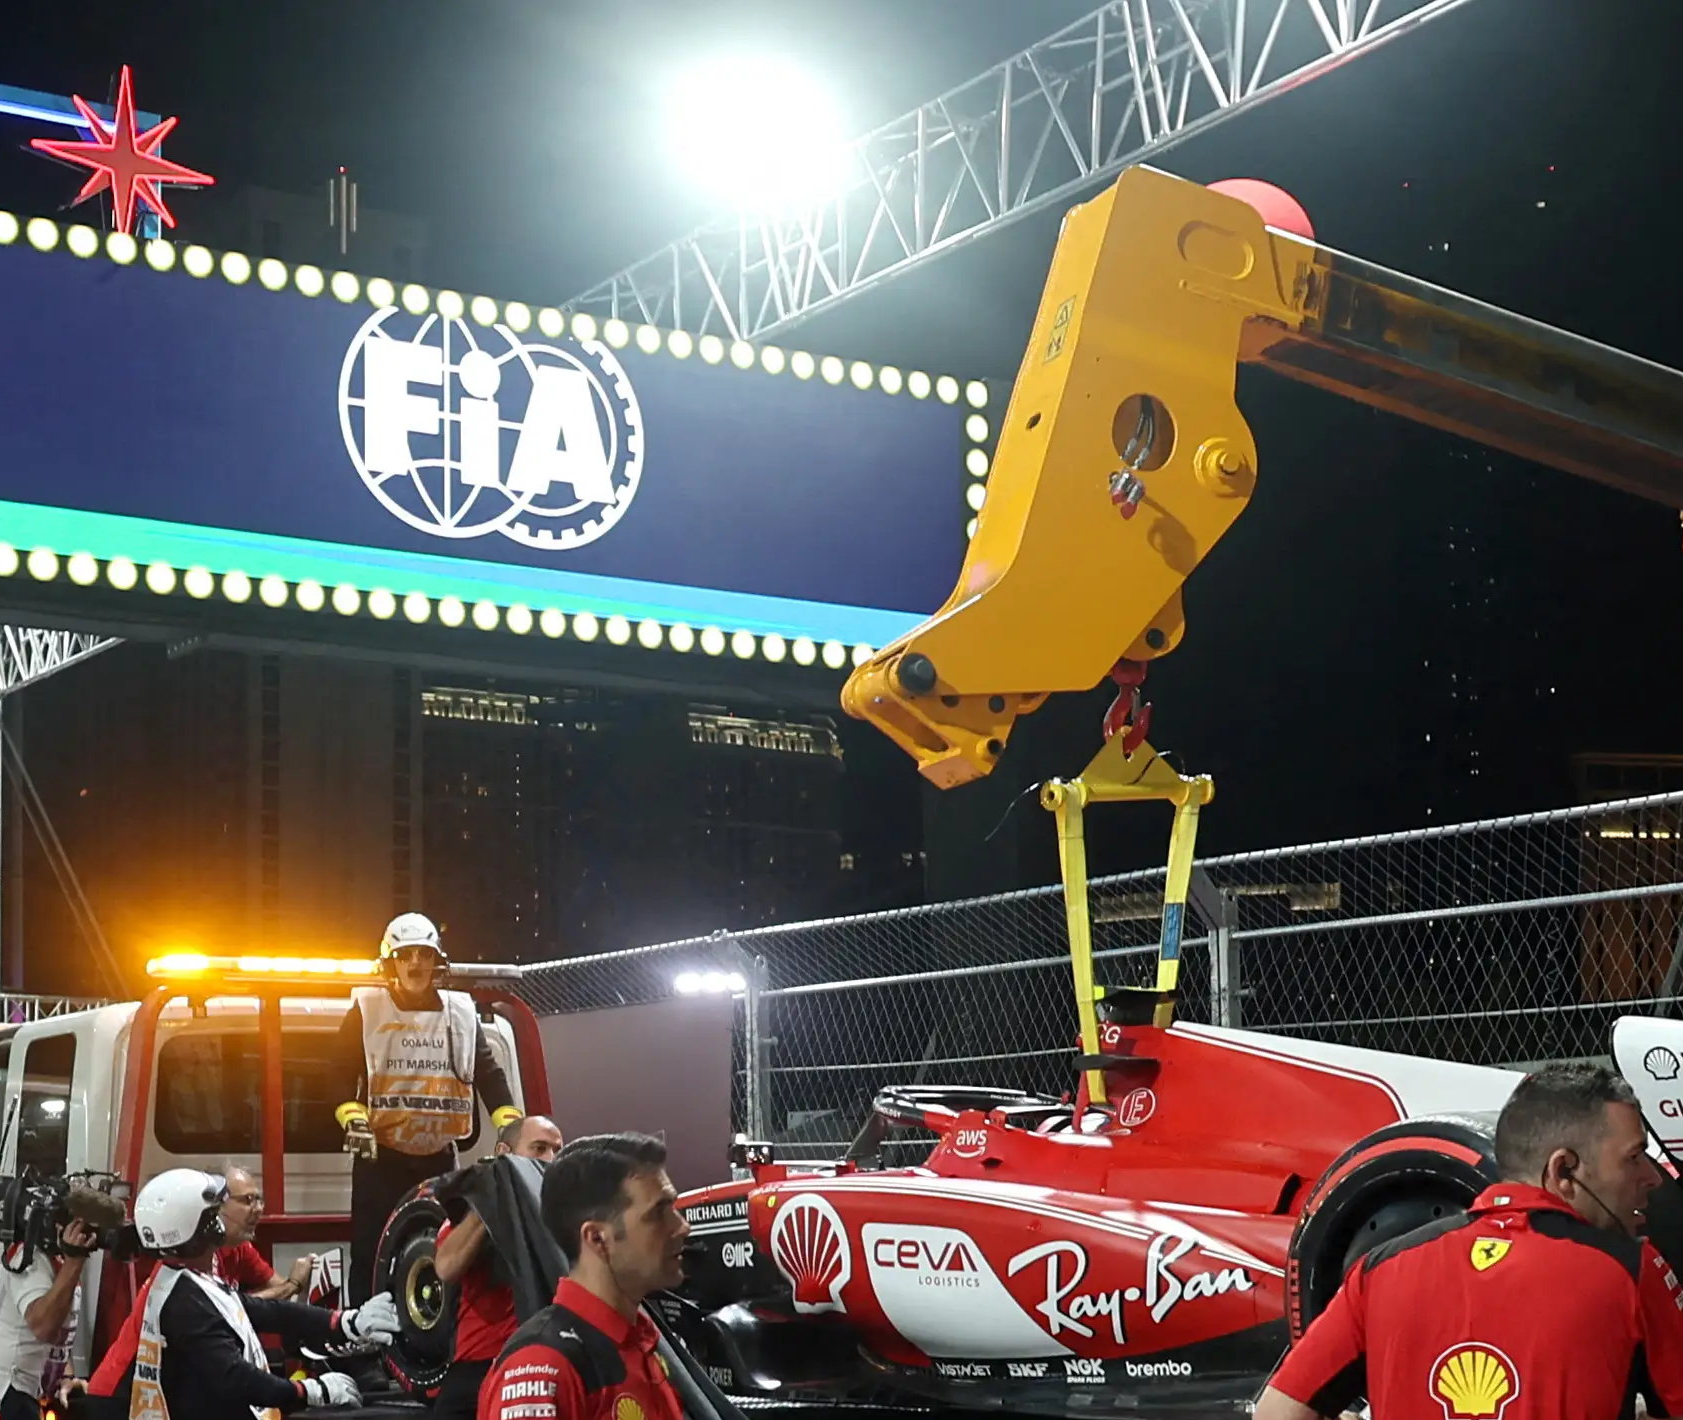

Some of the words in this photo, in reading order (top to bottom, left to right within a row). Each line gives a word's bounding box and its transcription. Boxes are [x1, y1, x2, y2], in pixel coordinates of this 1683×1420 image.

[386, 1059, 404, 1070] PIT
[407, 1060, 454, 1071] MARSHA
[956, 1129, 987, 1146] aws
[686, 1203, 732, 1221] RICHARD
[919, 1276, 980, 1288] LOGISTICS
[1009, 1232, 1254, 1344] Ray-Ban
[1007, 1363, 1048, 1377] SKF
[1063, 1358, 1106, 1376] NGK
[1125, 1360, 1192, 1377] brembo
[501, 1380, 557, 1402] MAHLE
